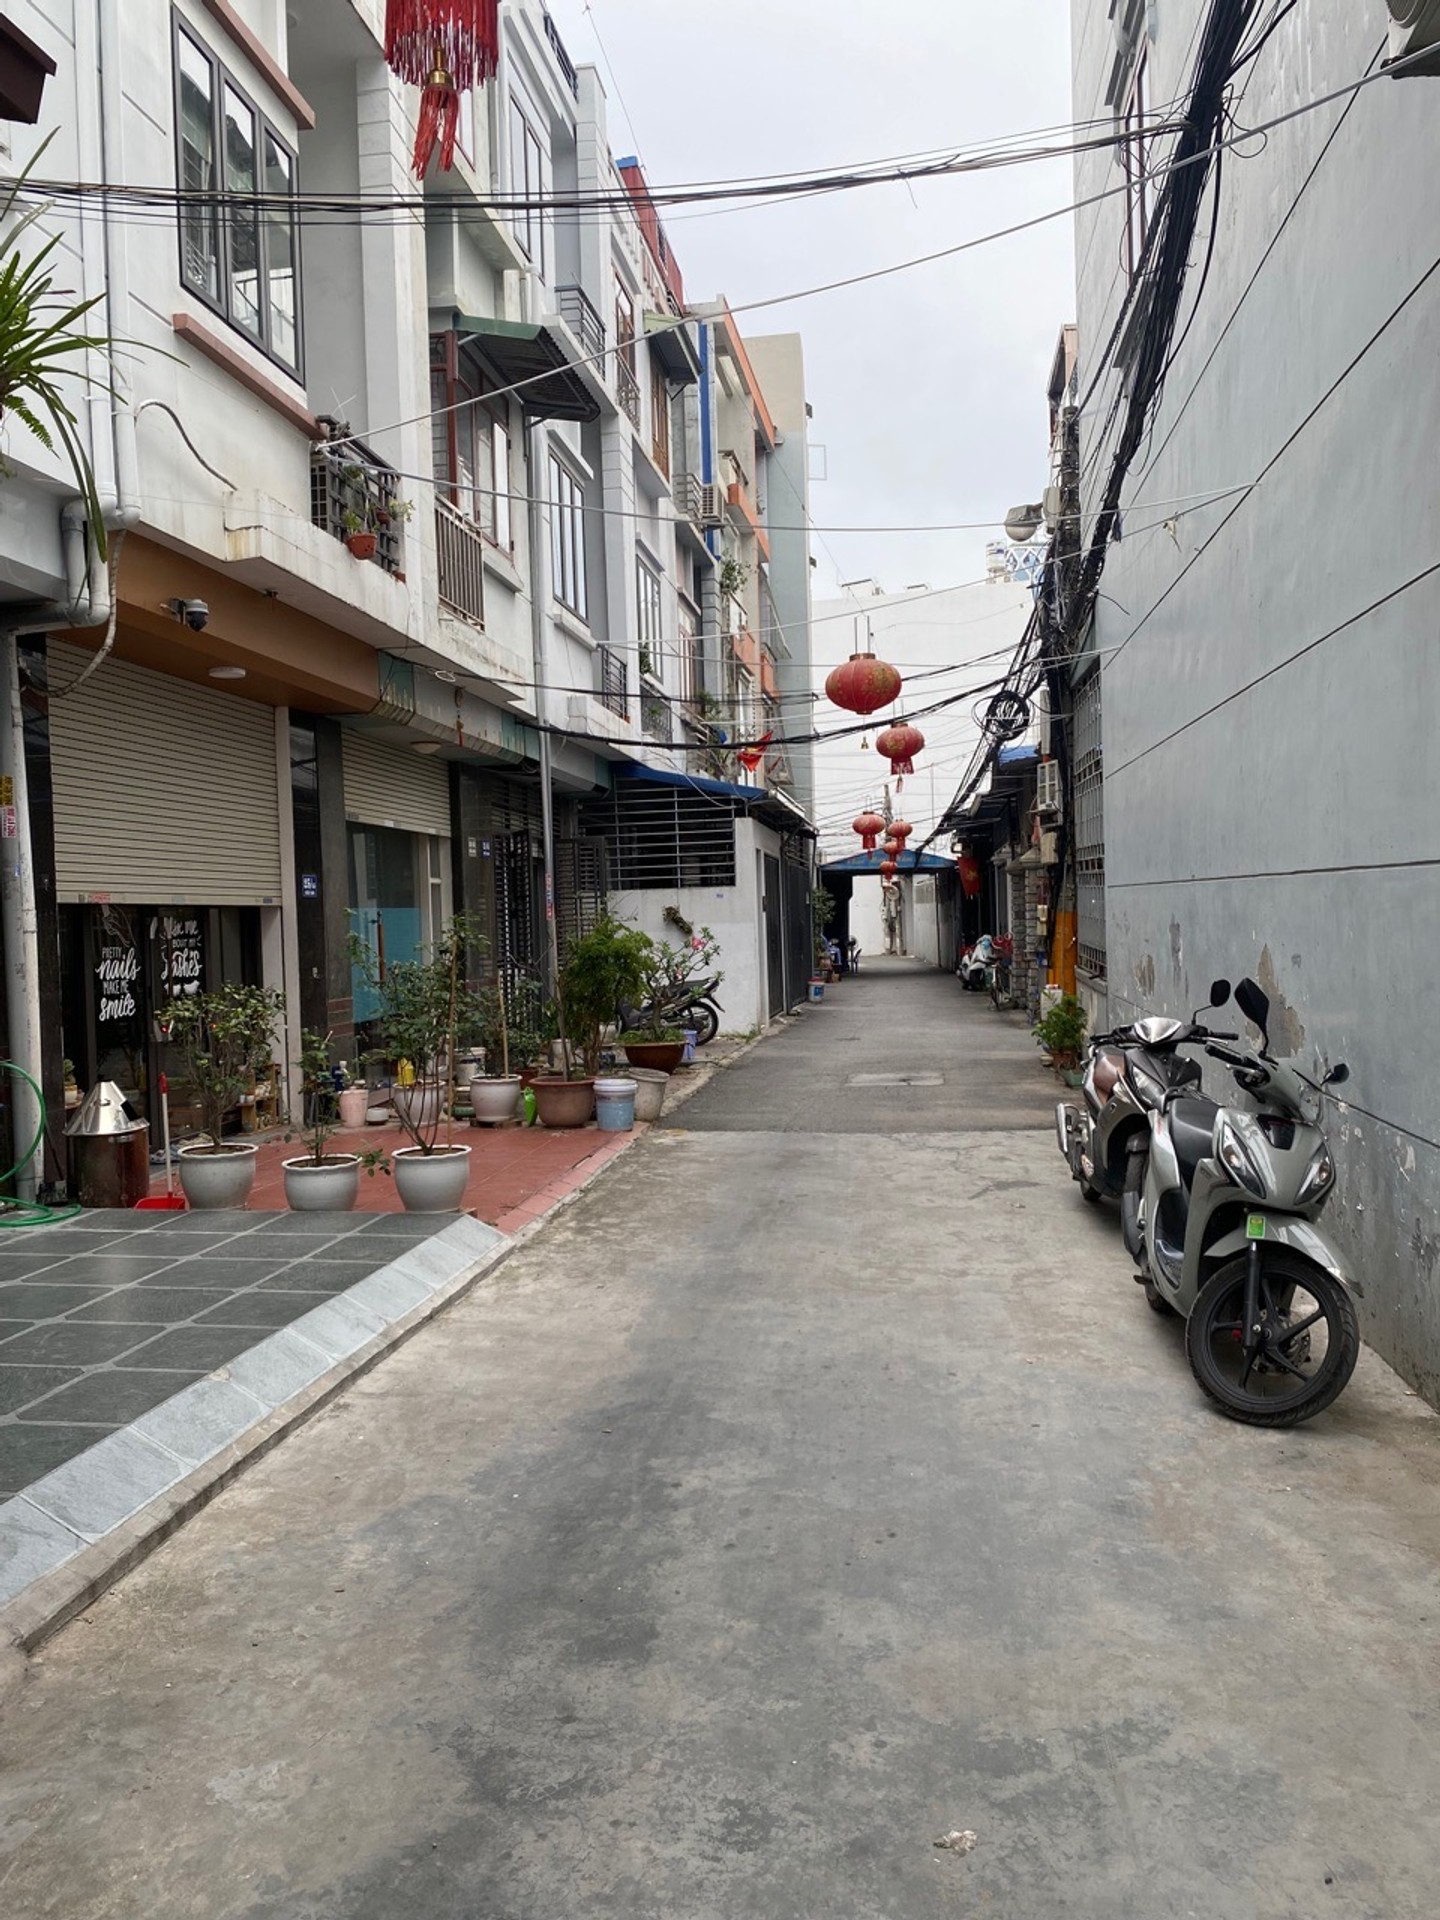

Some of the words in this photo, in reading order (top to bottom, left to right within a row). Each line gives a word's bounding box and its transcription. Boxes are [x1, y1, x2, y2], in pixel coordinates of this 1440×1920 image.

[102, 946, 122, 958] PRETTY
[95, 947, 141, 980] nails
[103, 980, 120, 995] MAKE
[120, 979, 129, 993] ME
[99, 993, 136, 1022] smile
